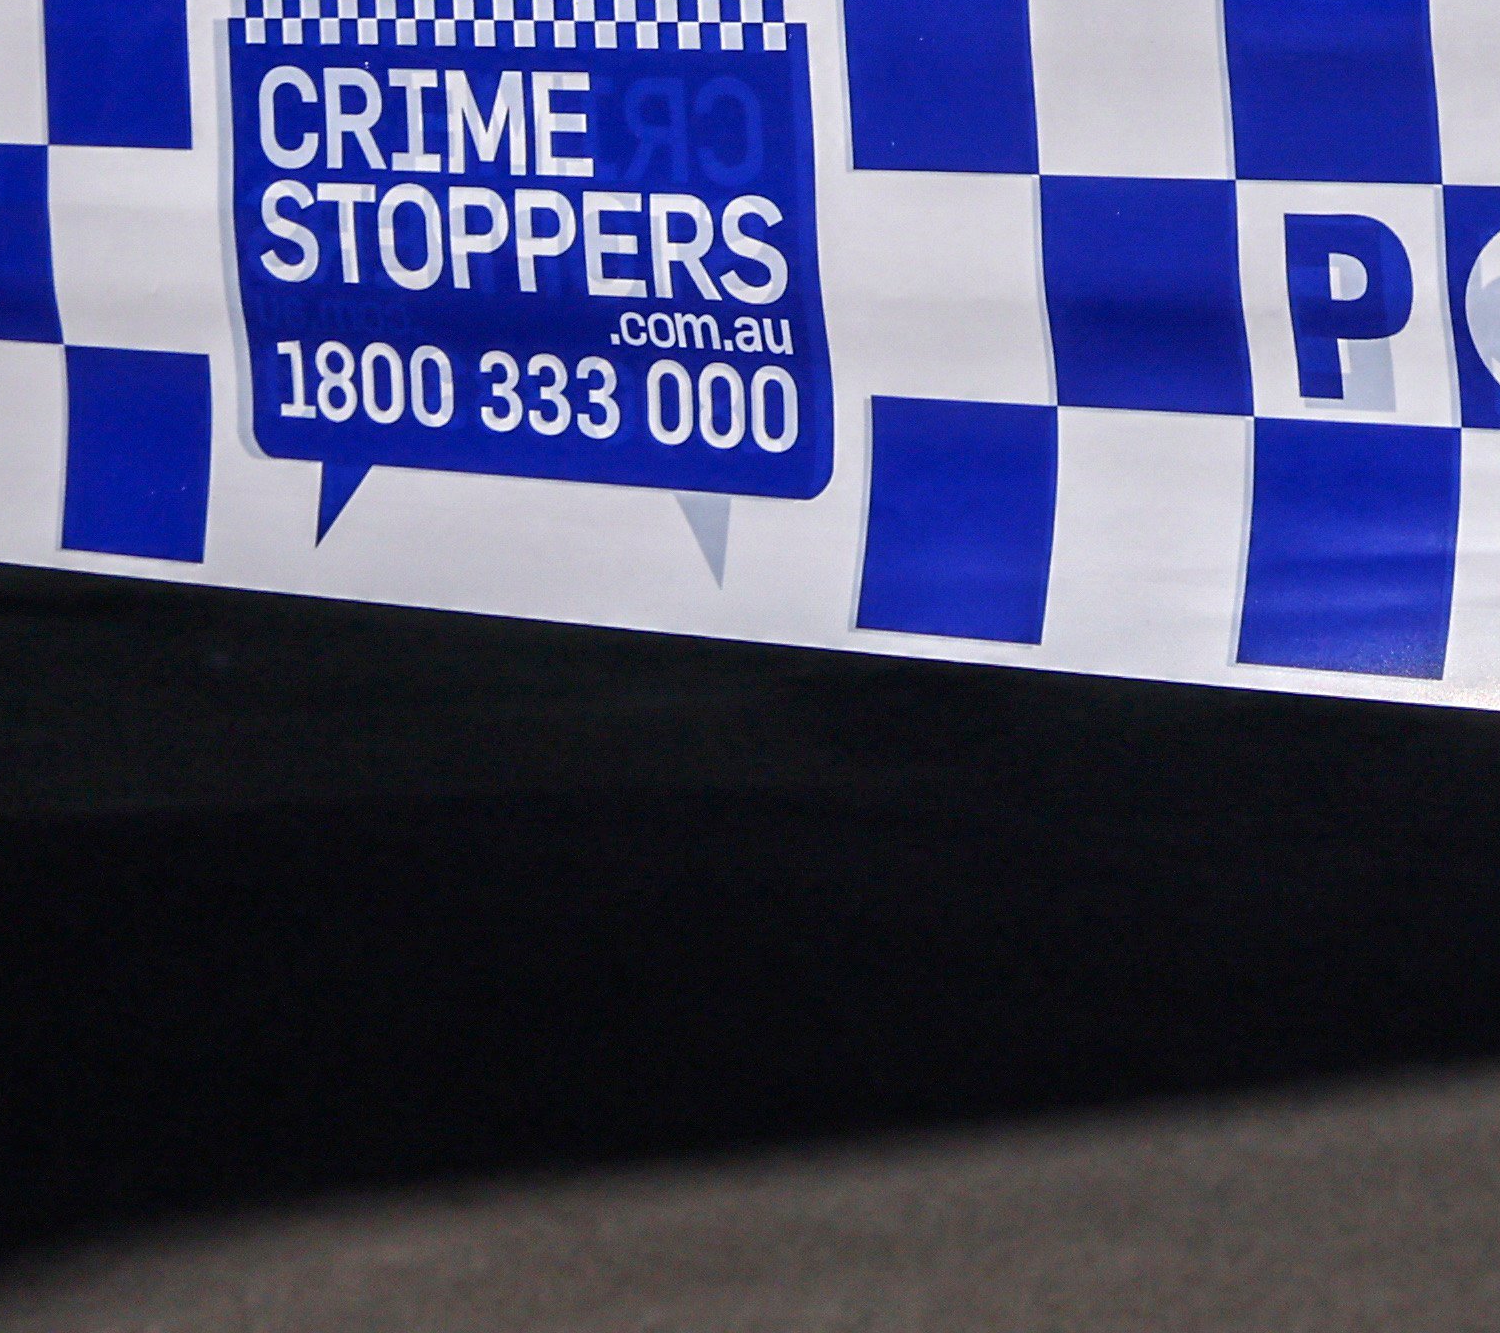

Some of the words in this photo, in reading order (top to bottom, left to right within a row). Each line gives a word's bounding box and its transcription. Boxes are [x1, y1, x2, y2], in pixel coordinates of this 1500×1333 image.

[258, 65, 594, 178] CRIME
[259, 179, 789, 305] STOPPERS
[610, 310, 794, 355] .com.au
[277, 340, 455, 429] 1800
[479, 350, 621, 440] 333
[646, 358, 798, 453] 000
